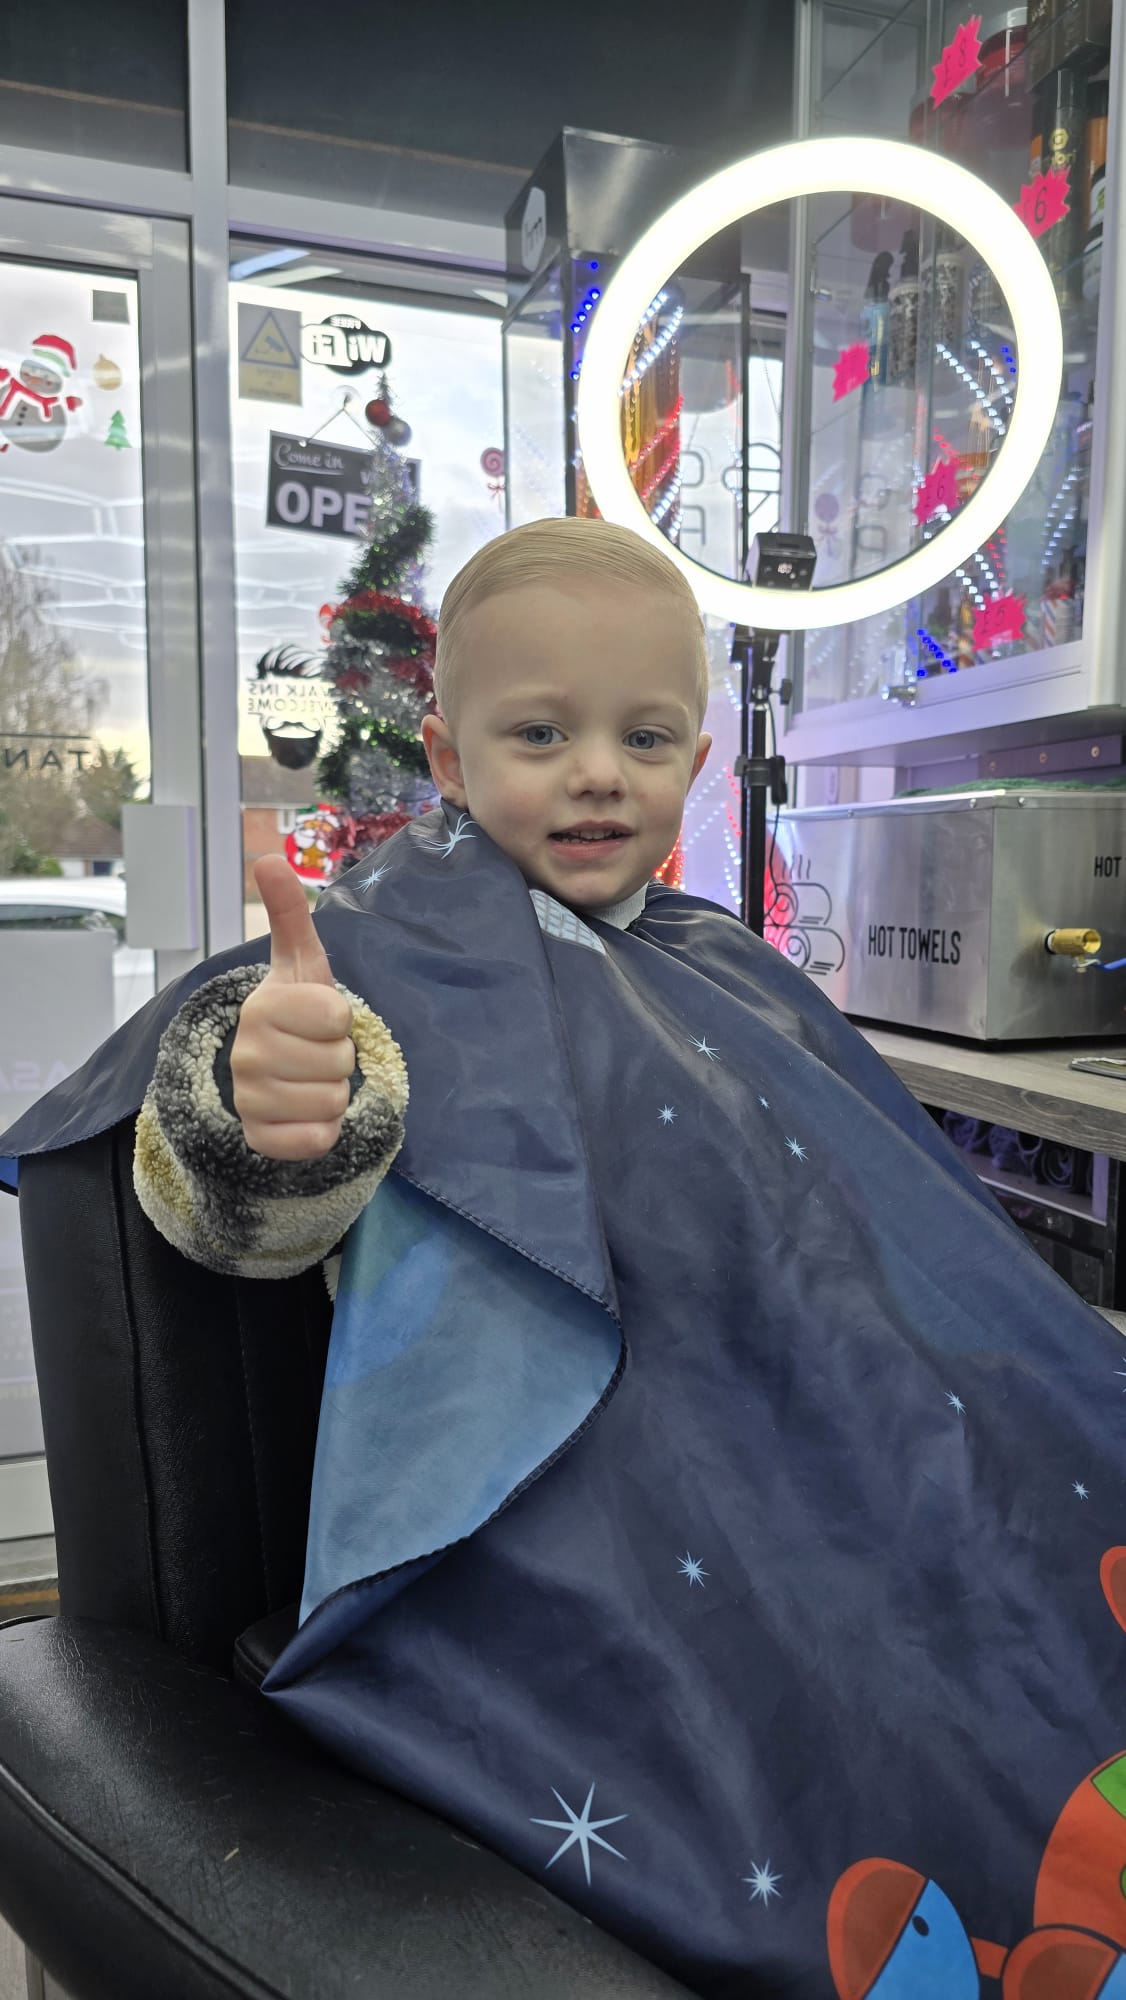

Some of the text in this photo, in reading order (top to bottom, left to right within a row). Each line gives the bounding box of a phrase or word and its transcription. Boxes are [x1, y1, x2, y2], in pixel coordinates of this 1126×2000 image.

[274, 442, 344, 469] Come in
[275, 480, 373, 536] OPE
[1094, 855, 1122, 878] HOT
[868, 924, 961, 965] HOT TOWELS
